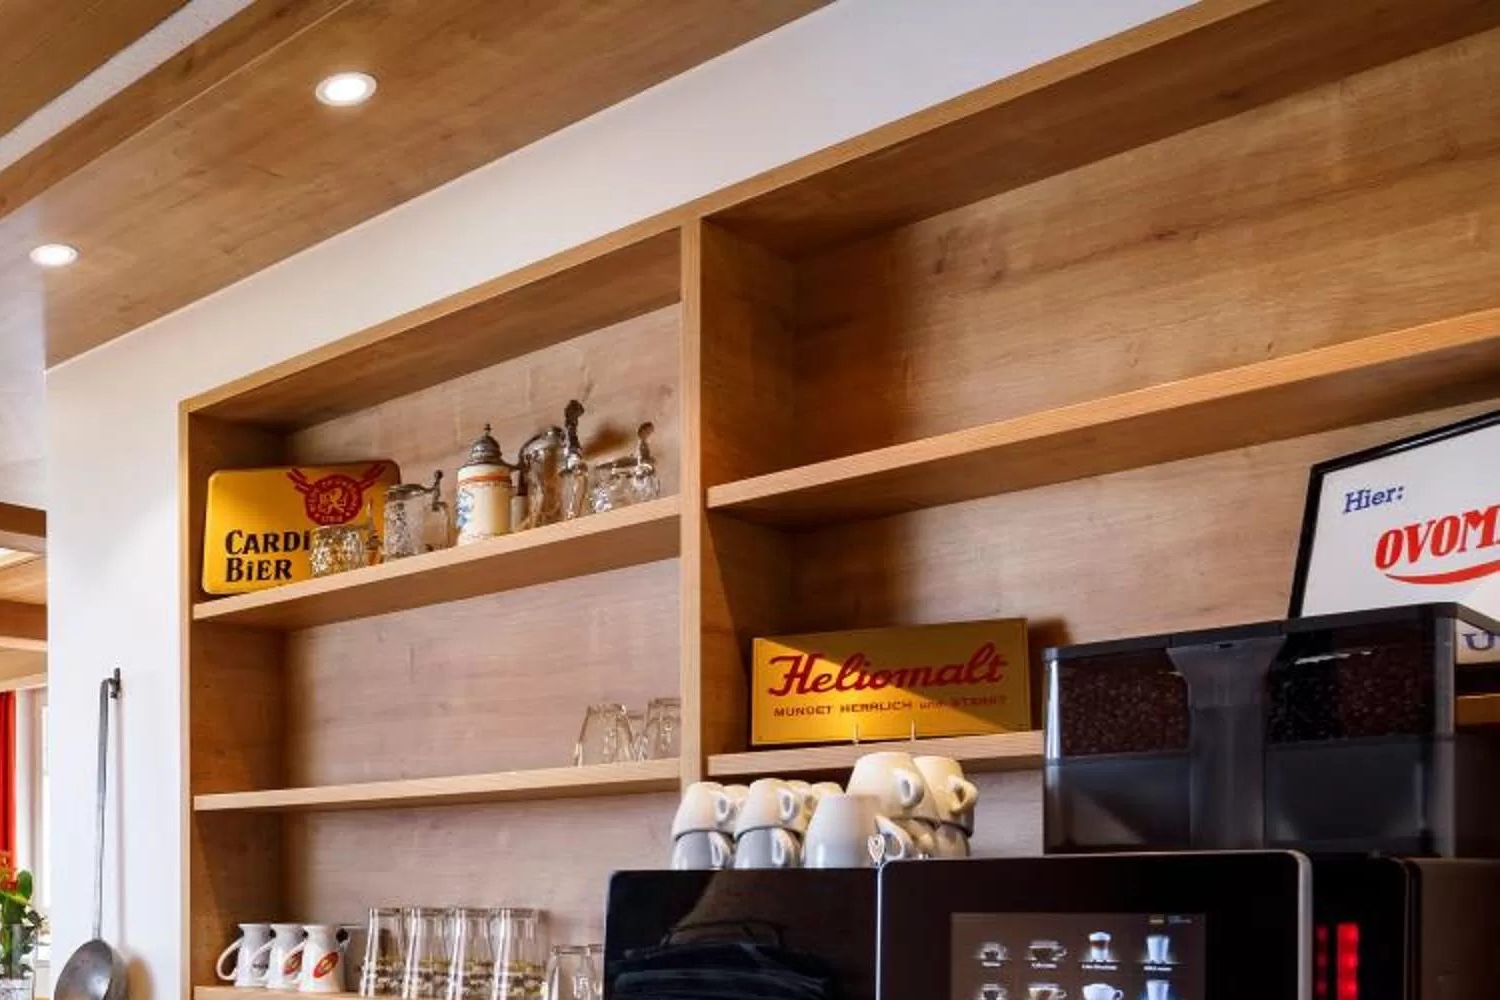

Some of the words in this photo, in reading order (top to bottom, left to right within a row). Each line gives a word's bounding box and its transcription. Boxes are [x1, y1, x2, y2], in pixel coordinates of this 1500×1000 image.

[1342, 486, 1405, 514] Hier:
[1373, 504, 1500, 571] OVOM
[768, 641, 1009, 698] Heliomalt
